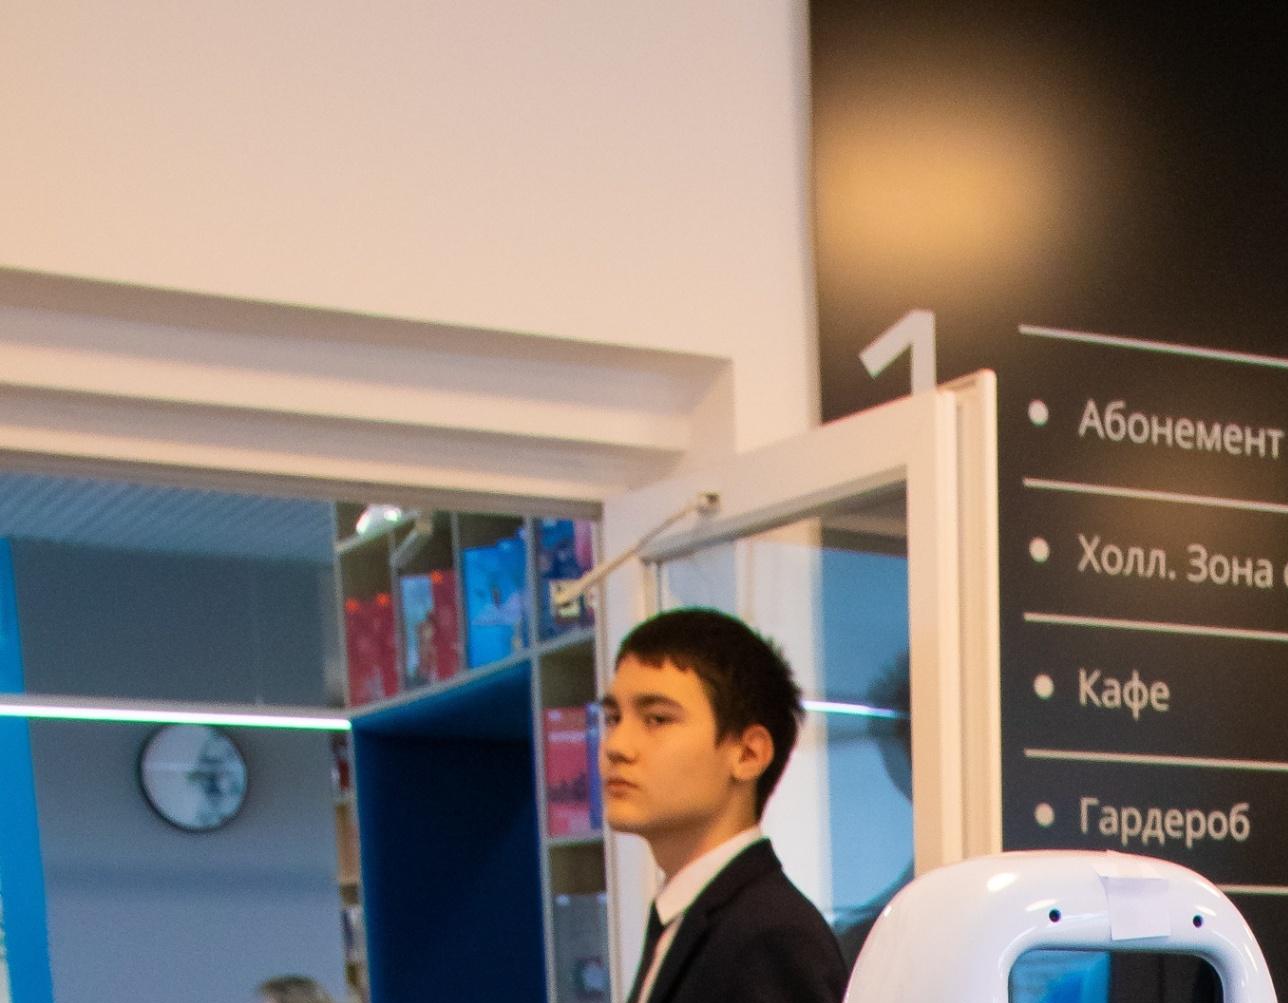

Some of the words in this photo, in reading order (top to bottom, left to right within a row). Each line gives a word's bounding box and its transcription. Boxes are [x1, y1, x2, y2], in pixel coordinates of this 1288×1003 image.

[1078, 399, 1285, 459] Абонемент
[1077, 533, 1176, 581] Холл.
[1188, 543, 1274, 589] Зона
[1078, 669, 1171, 720] Кафе
[1079, 797, 1251, 848] Гардероб
